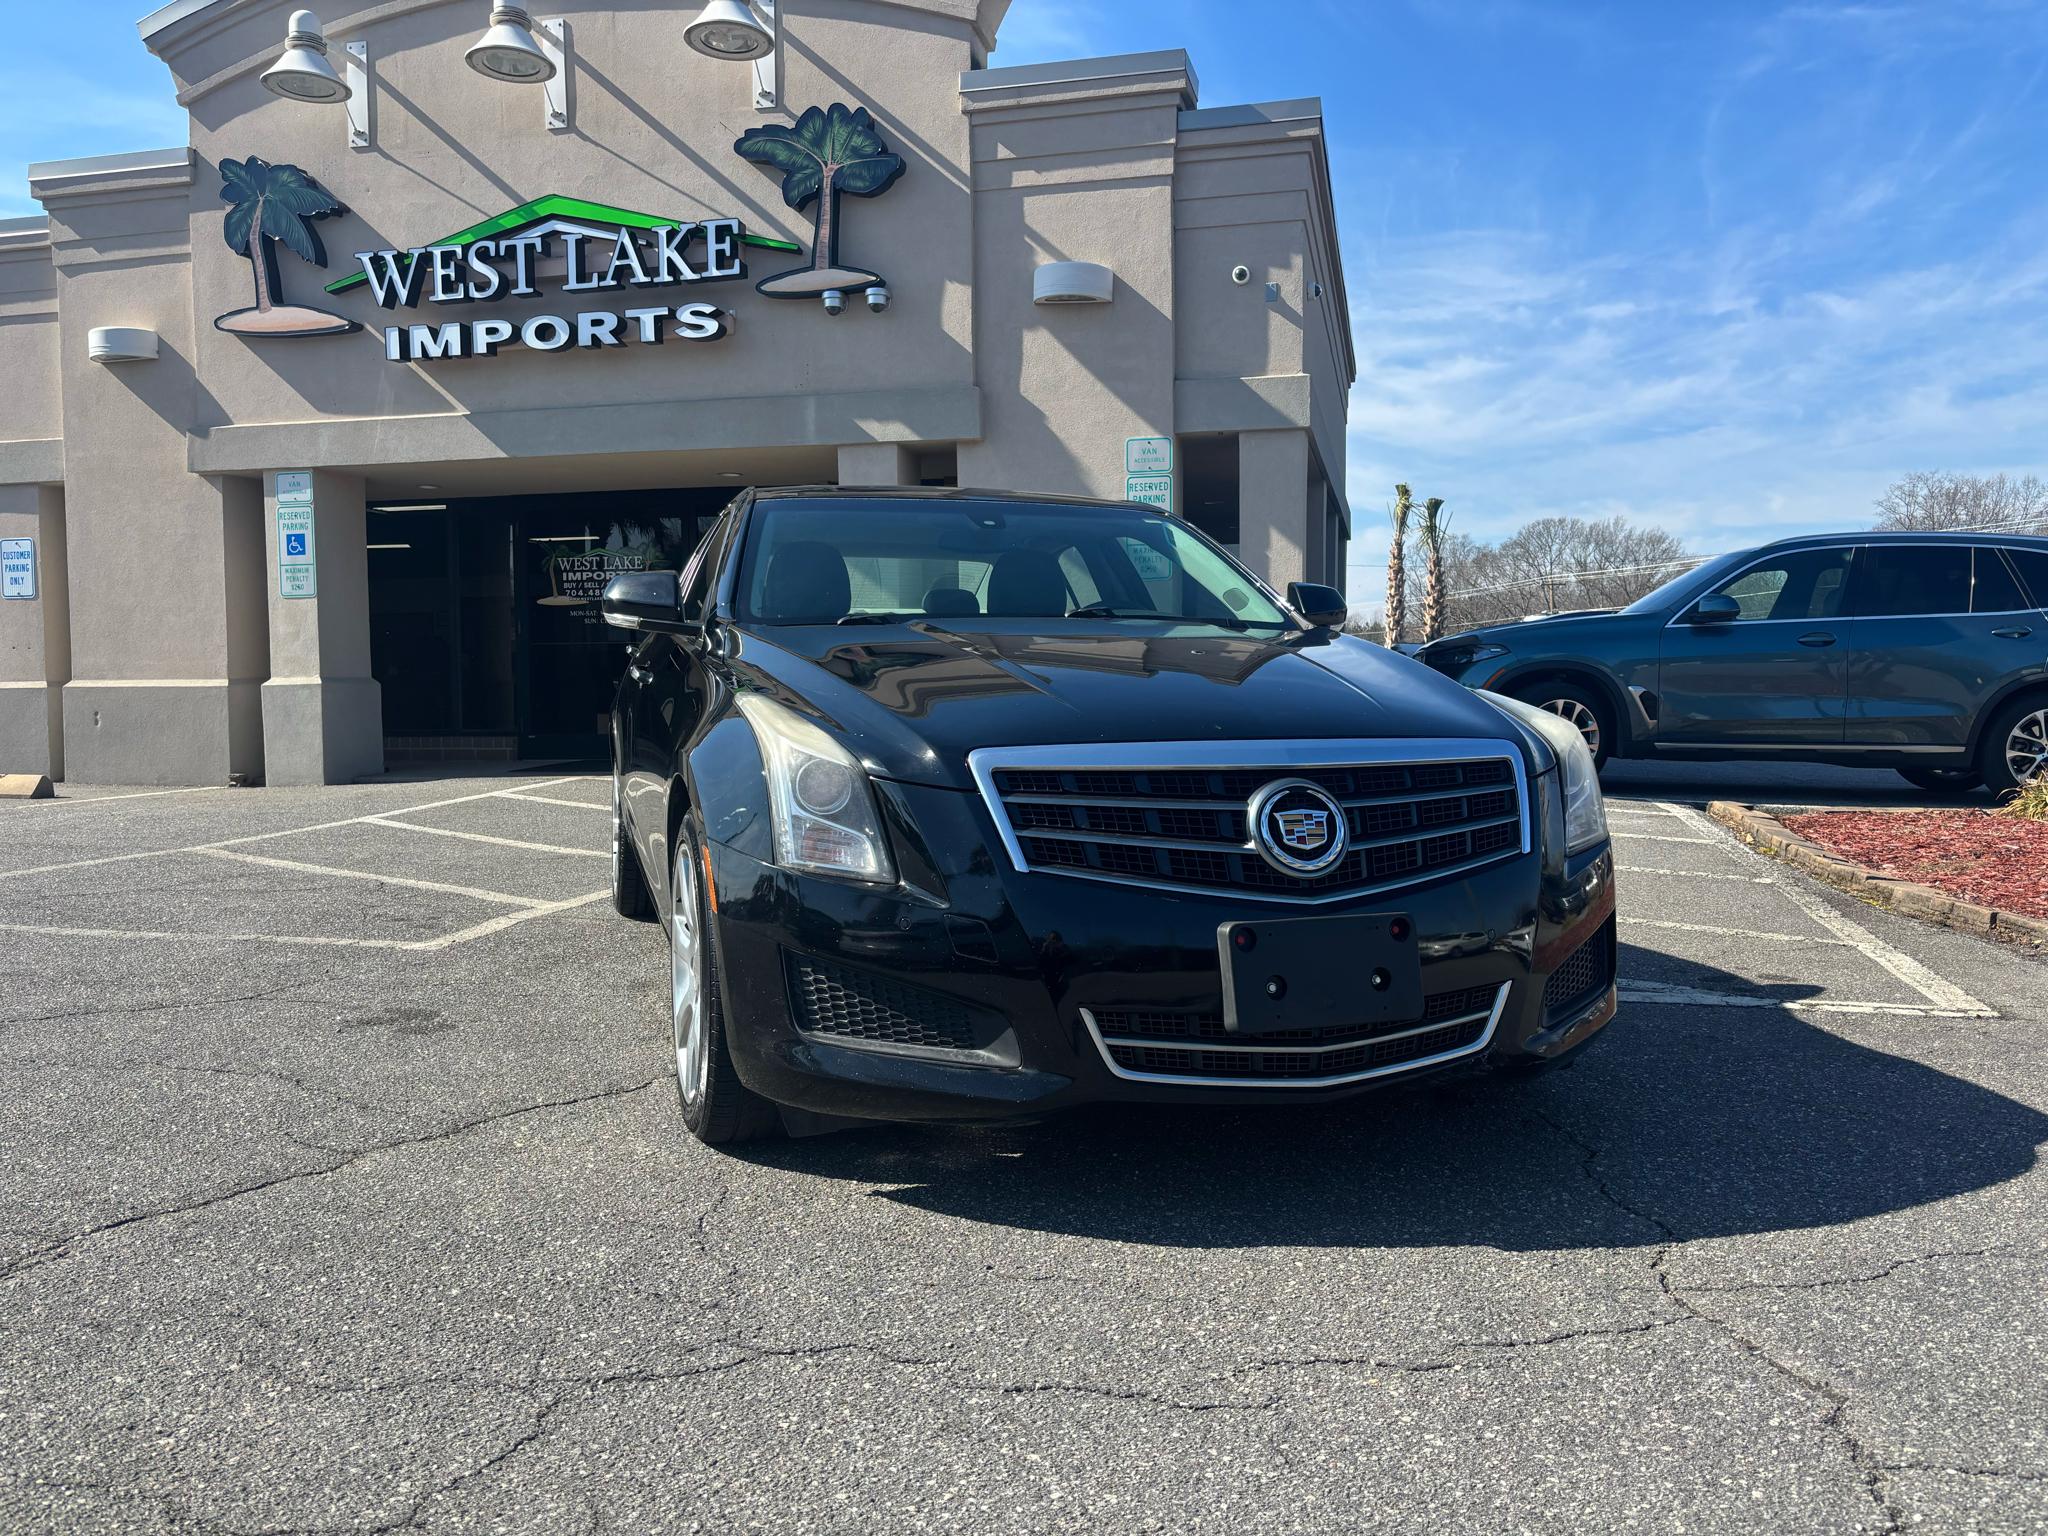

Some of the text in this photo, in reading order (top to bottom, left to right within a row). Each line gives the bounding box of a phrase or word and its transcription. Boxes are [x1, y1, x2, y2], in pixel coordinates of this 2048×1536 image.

[354, 217, 748, 308] WEST LAKE
[384, 301, 728, 362] IMPORTS
[1141, 447, 1158, 455] VAN
[1129, 481, 1169, 493] RESERVED
[1132, 493, 1166, 503] PARKING
[279, 511, 310, 520] RESERVED
[282, 522, 309, 531] PARKING
[3, 551, 30, 560] CUSTOMER
[5, 563, 30, 573] PARKING
[556, 555, 643, 571] WEST LAKE
[10, 576, 24, 586] ONLY
[286, 575, 309, 583] PENALTY
[562, 571, 637, 581] IMPOR
